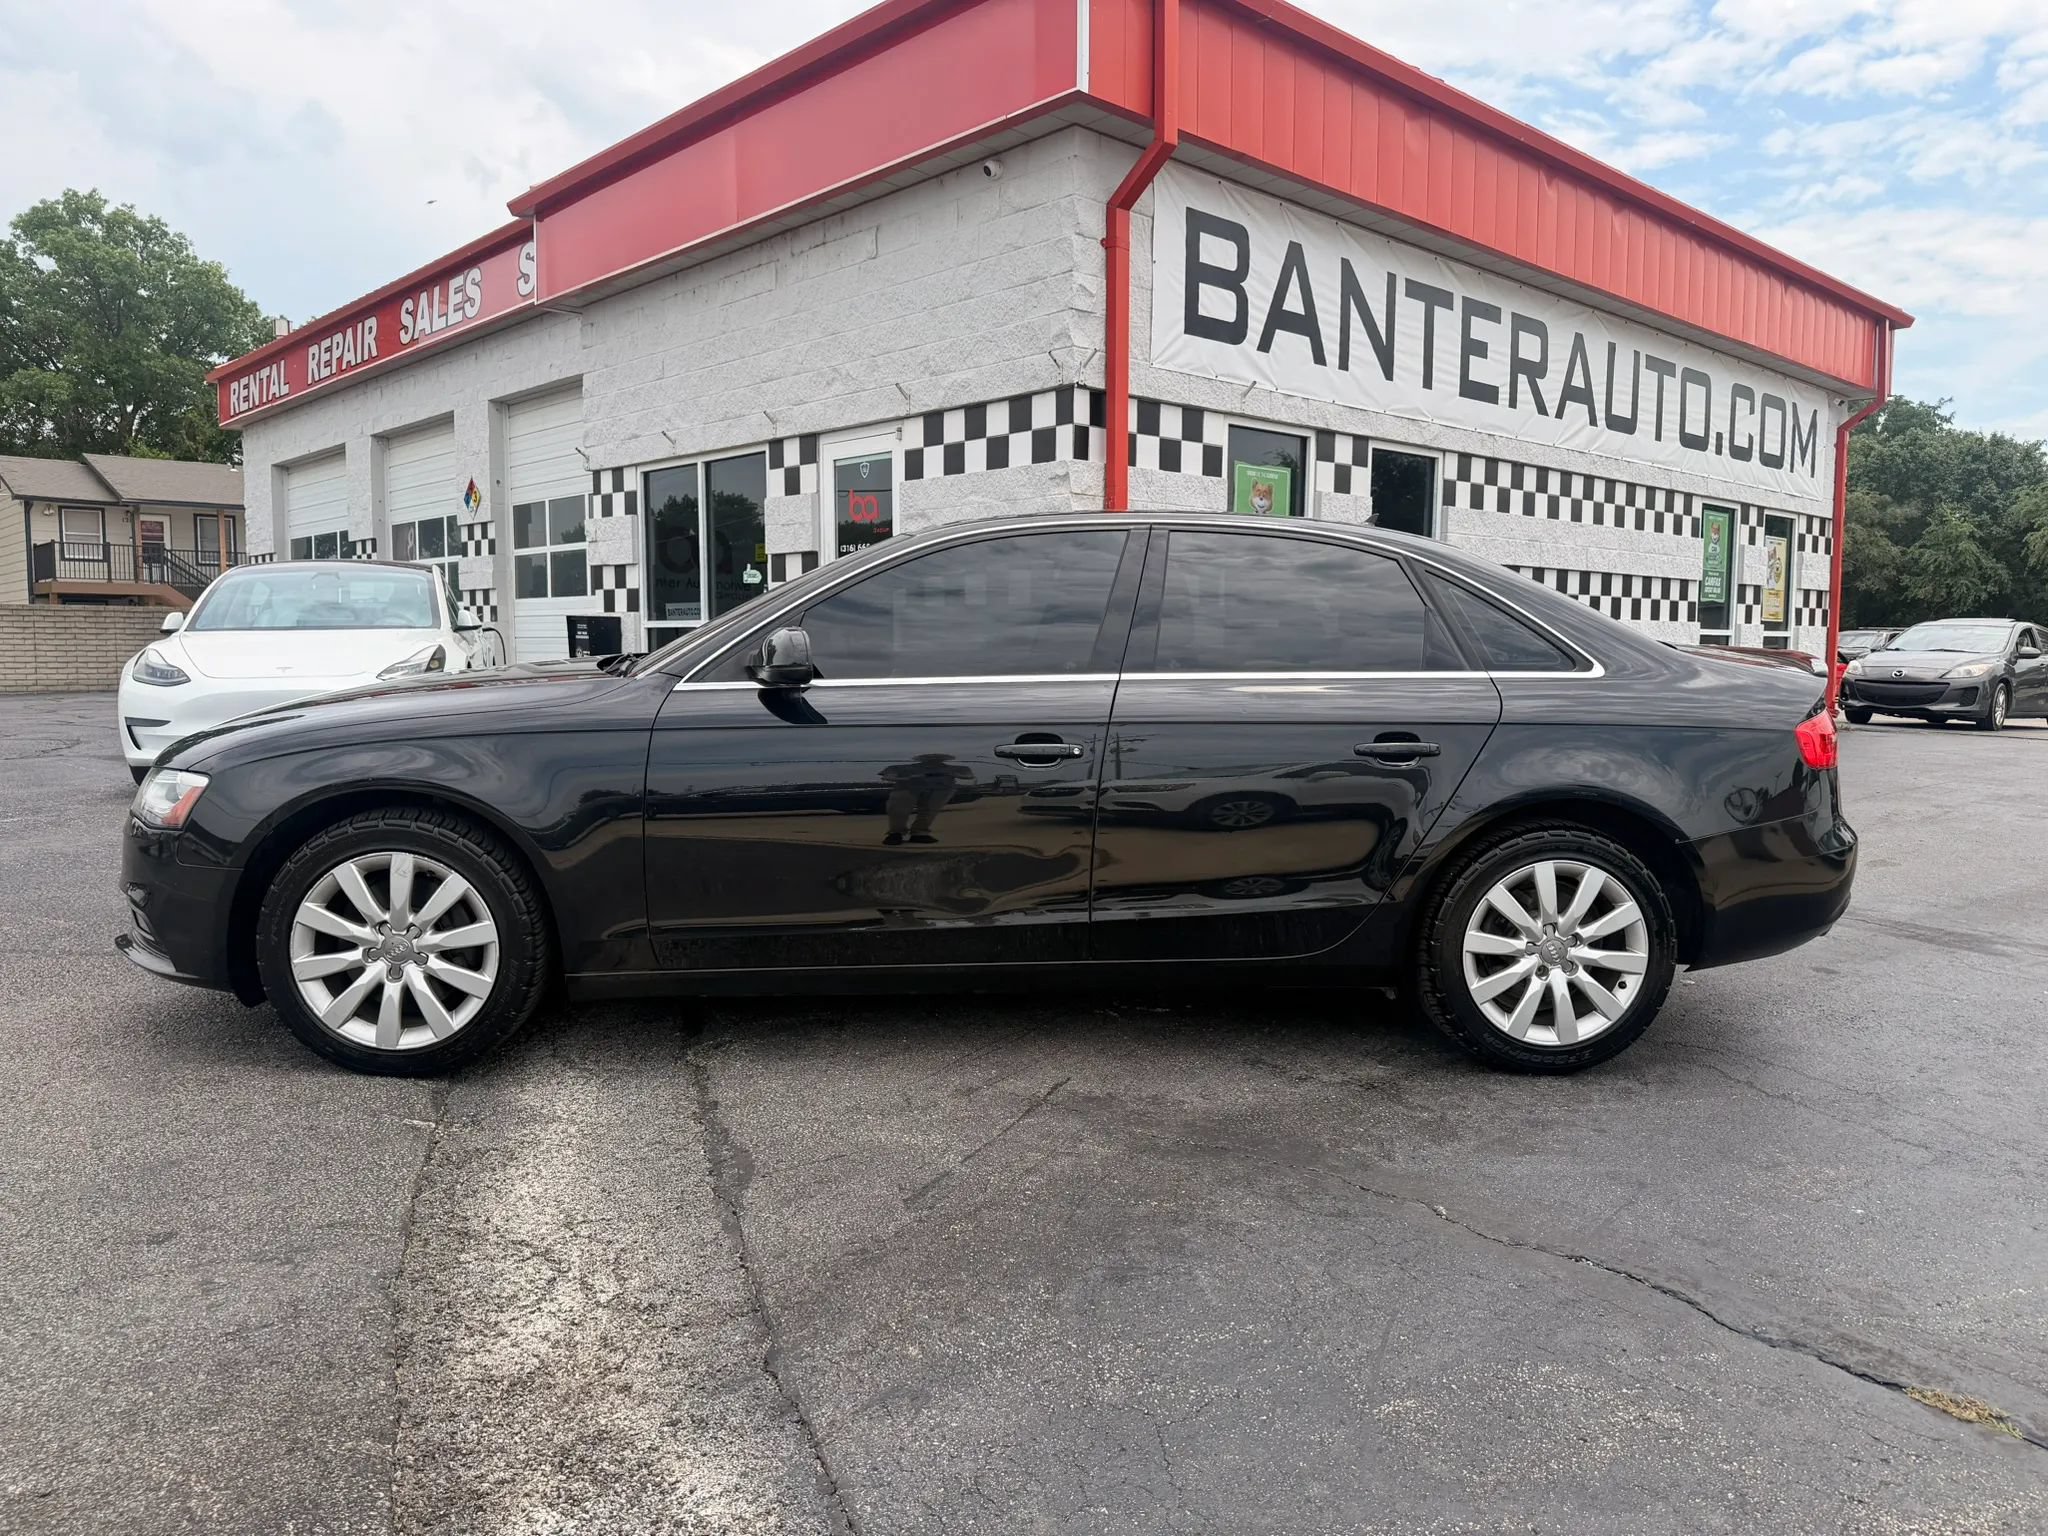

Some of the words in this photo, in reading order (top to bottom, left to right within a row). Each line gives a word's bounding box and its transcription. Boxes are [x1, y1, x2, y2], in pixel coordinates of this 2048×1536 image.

[230, 360, 290, 416] RENTAL
[307, 316, 378, 386] REPAIR
[399, 267, 482, 345] SALES
[1183, 205, 1819, 479] BANTERAUTO.COM
